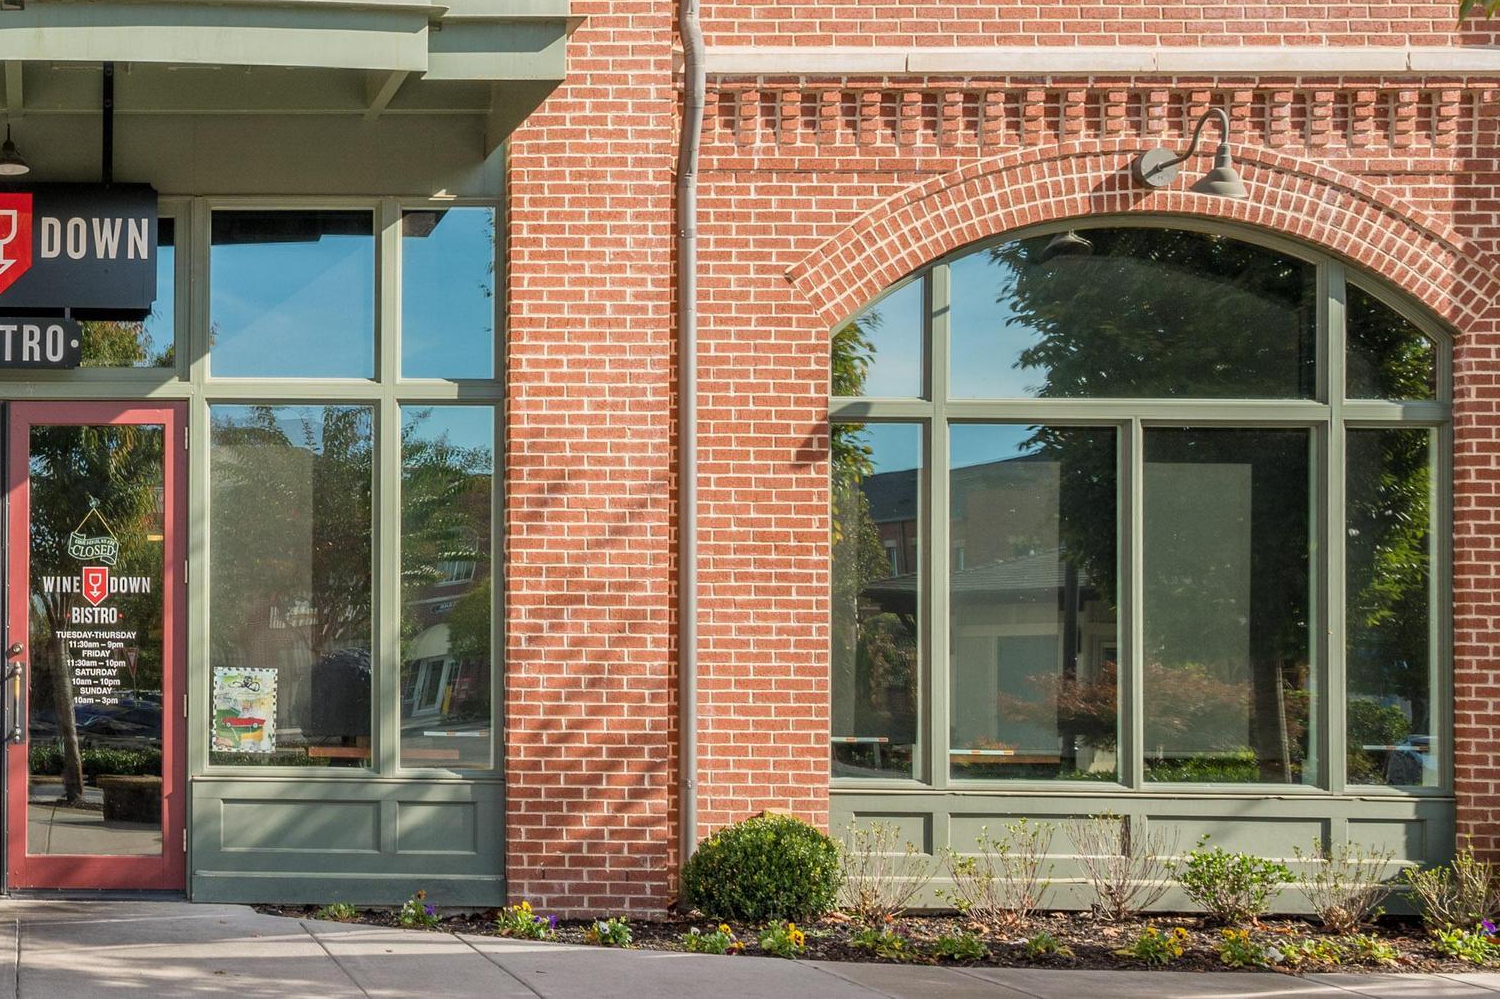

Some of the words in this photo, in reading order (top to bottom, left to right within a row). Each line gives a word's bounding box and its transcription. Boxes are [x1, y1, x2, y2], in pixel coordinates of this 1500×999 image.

[41, 217, 149, 260] DOWN
[72, 544, 115, 557] CLOSED
[43, 576, 81, 594] WINE
[109, 577, 151, 594] DOWN
[72, 607, 118, 624] BISTRO
[55, 631, 137, 639] TUESDAY-THURSDAY
[68, 641, 100, 649] 11:30am
[107, 641, 124, 650] 9pm
[82, 650, 111, 658] FRIDAY
[66, 659, 98, 667] 11:30am
[105, 659, 126, 668] 10pm
[74, 668, 118, 676] SATURDAY
[71, 678, 92, 686] 10am
[99, 678, 121, 687] 10pm
[80, 687, 113, 695] SUNDAY
[73, 697, 94, 705] 10am
[101, 697, 119, 706] 3pm
